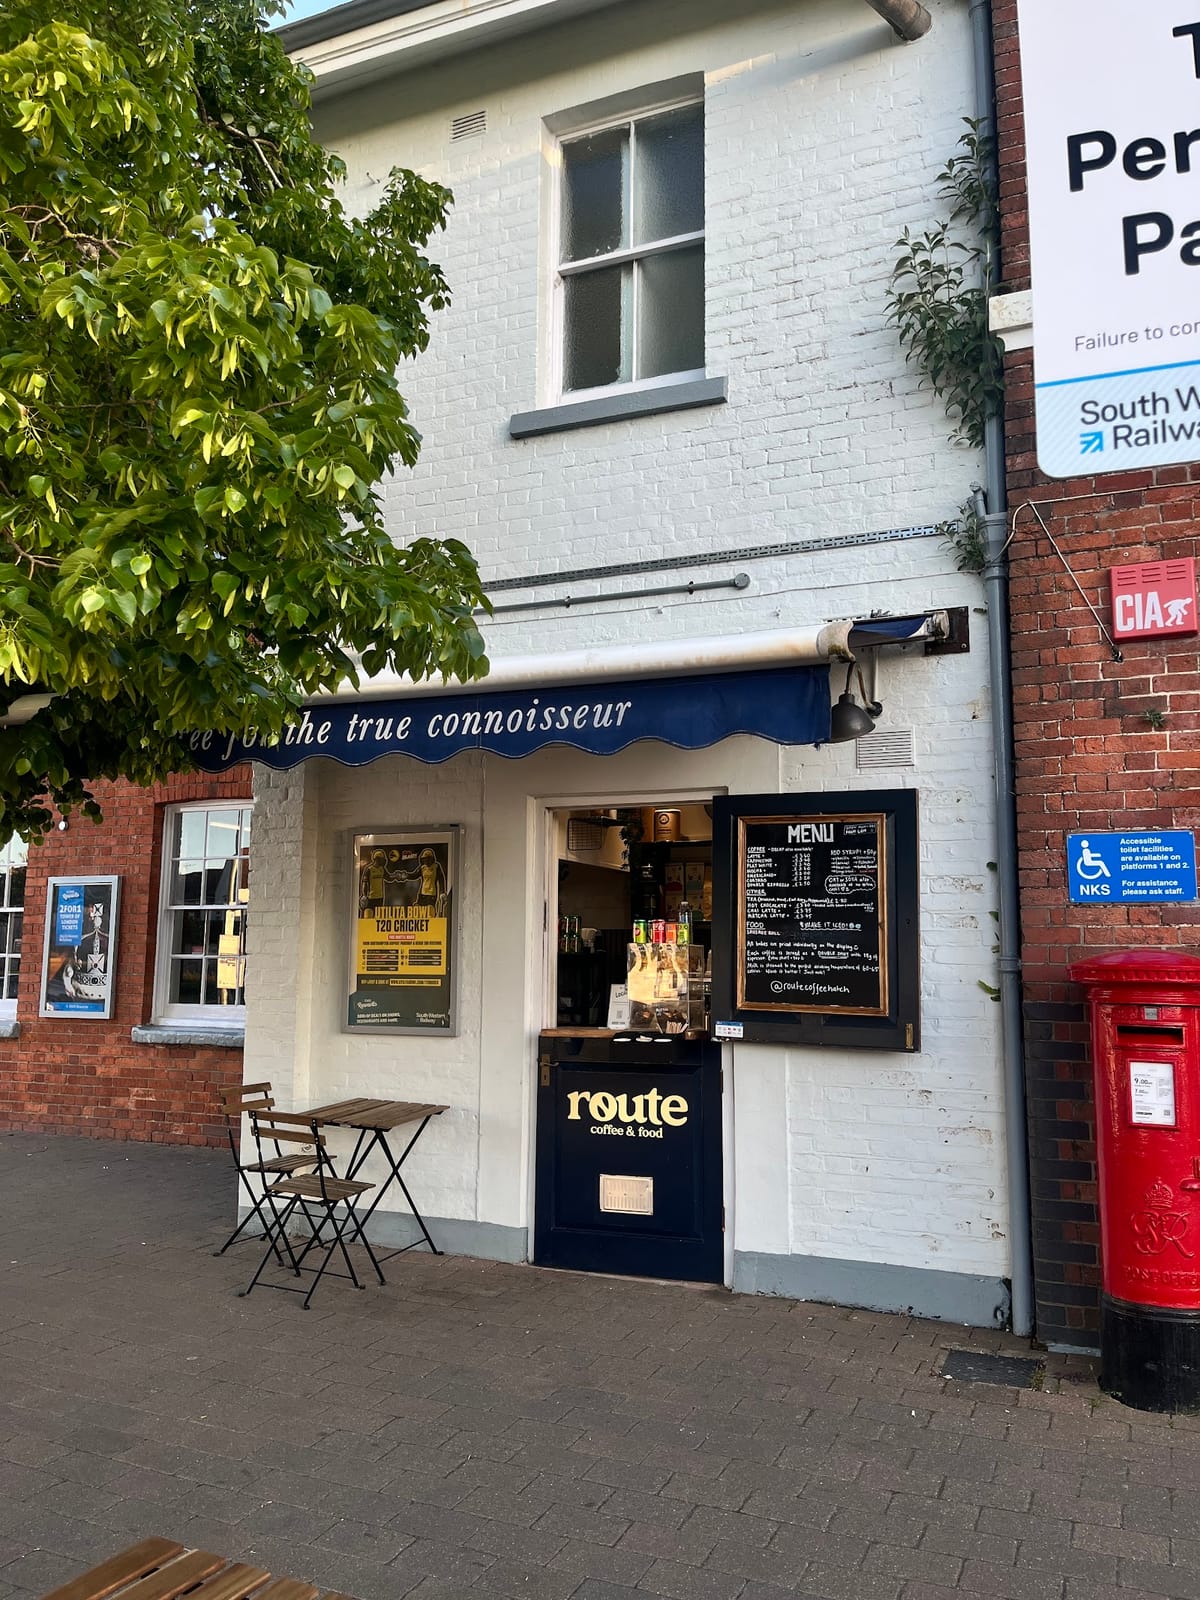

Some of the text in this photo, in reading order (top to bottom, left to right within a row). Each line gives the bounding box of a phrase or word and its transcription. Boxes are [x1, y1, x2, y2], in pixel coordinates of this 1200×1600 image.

[1075, 331, 1138, 352] Failure
[1144, 325, 1163, 341] to
[1080, 391, 1170, 425] South
[1115, 591, 1164, 632] CIA
[284, 711, 331, 746] the
[345, 712, 410, 743] true
[427, 698, 632, 738] connoisseur
[787, 824, 834, 843] MENU
[1120, 837, 1162, 845] Accessible
[1121, 863, 1157, 871] platforms
[1080, 884, 1111, 896] NKS
[375, 906, 433, 919] UTILITA BOWL
[376, 919, 430, 932] T20 CRICKET
[770, 980, 850, 996] @routecoffeehatch
[567, 1087, 689, 1127] route
[590, 1124, 663, 1139] coffee & food
